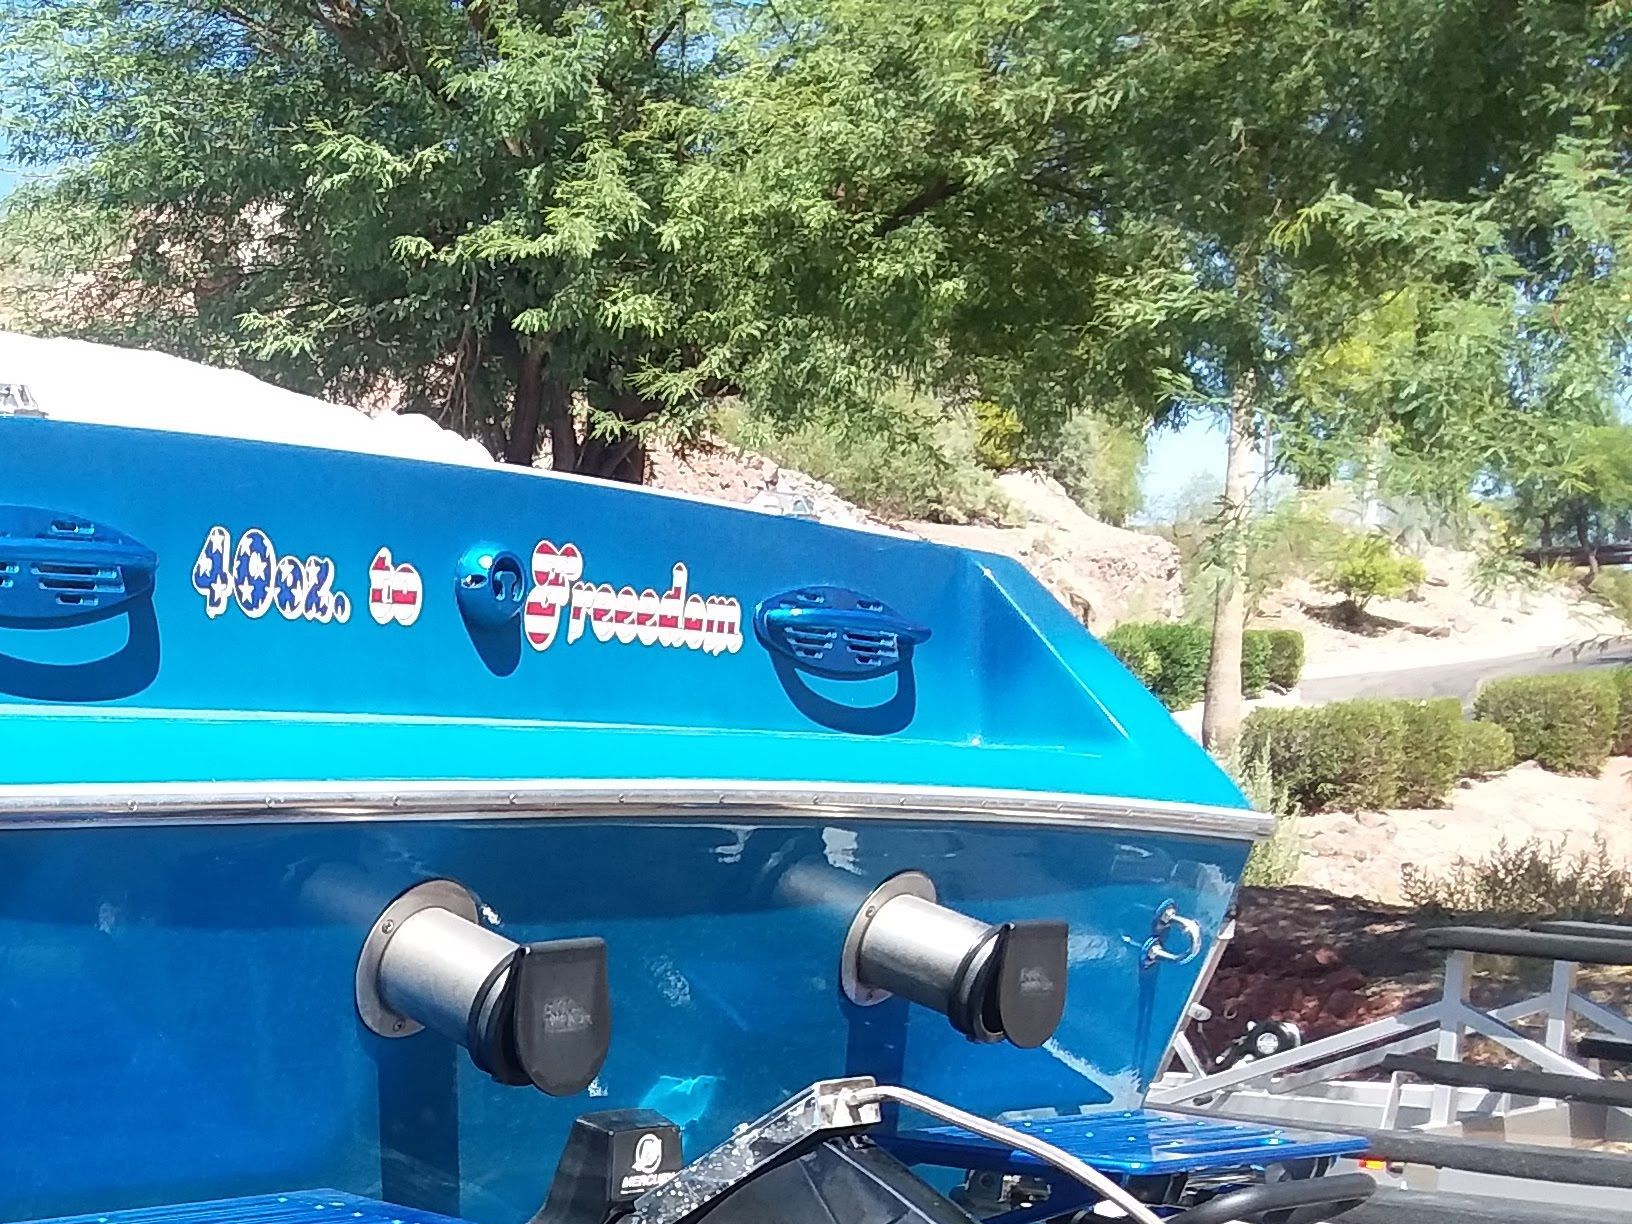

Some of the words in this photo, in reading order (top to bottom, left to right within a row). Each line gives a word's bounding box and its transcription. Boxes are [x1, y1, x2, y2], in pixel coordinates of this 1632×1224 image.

[368, 547, 423, 627] to
[523, 540, 744, 656] Freedom
[621, 1172, 678, 1189] MERCUR
